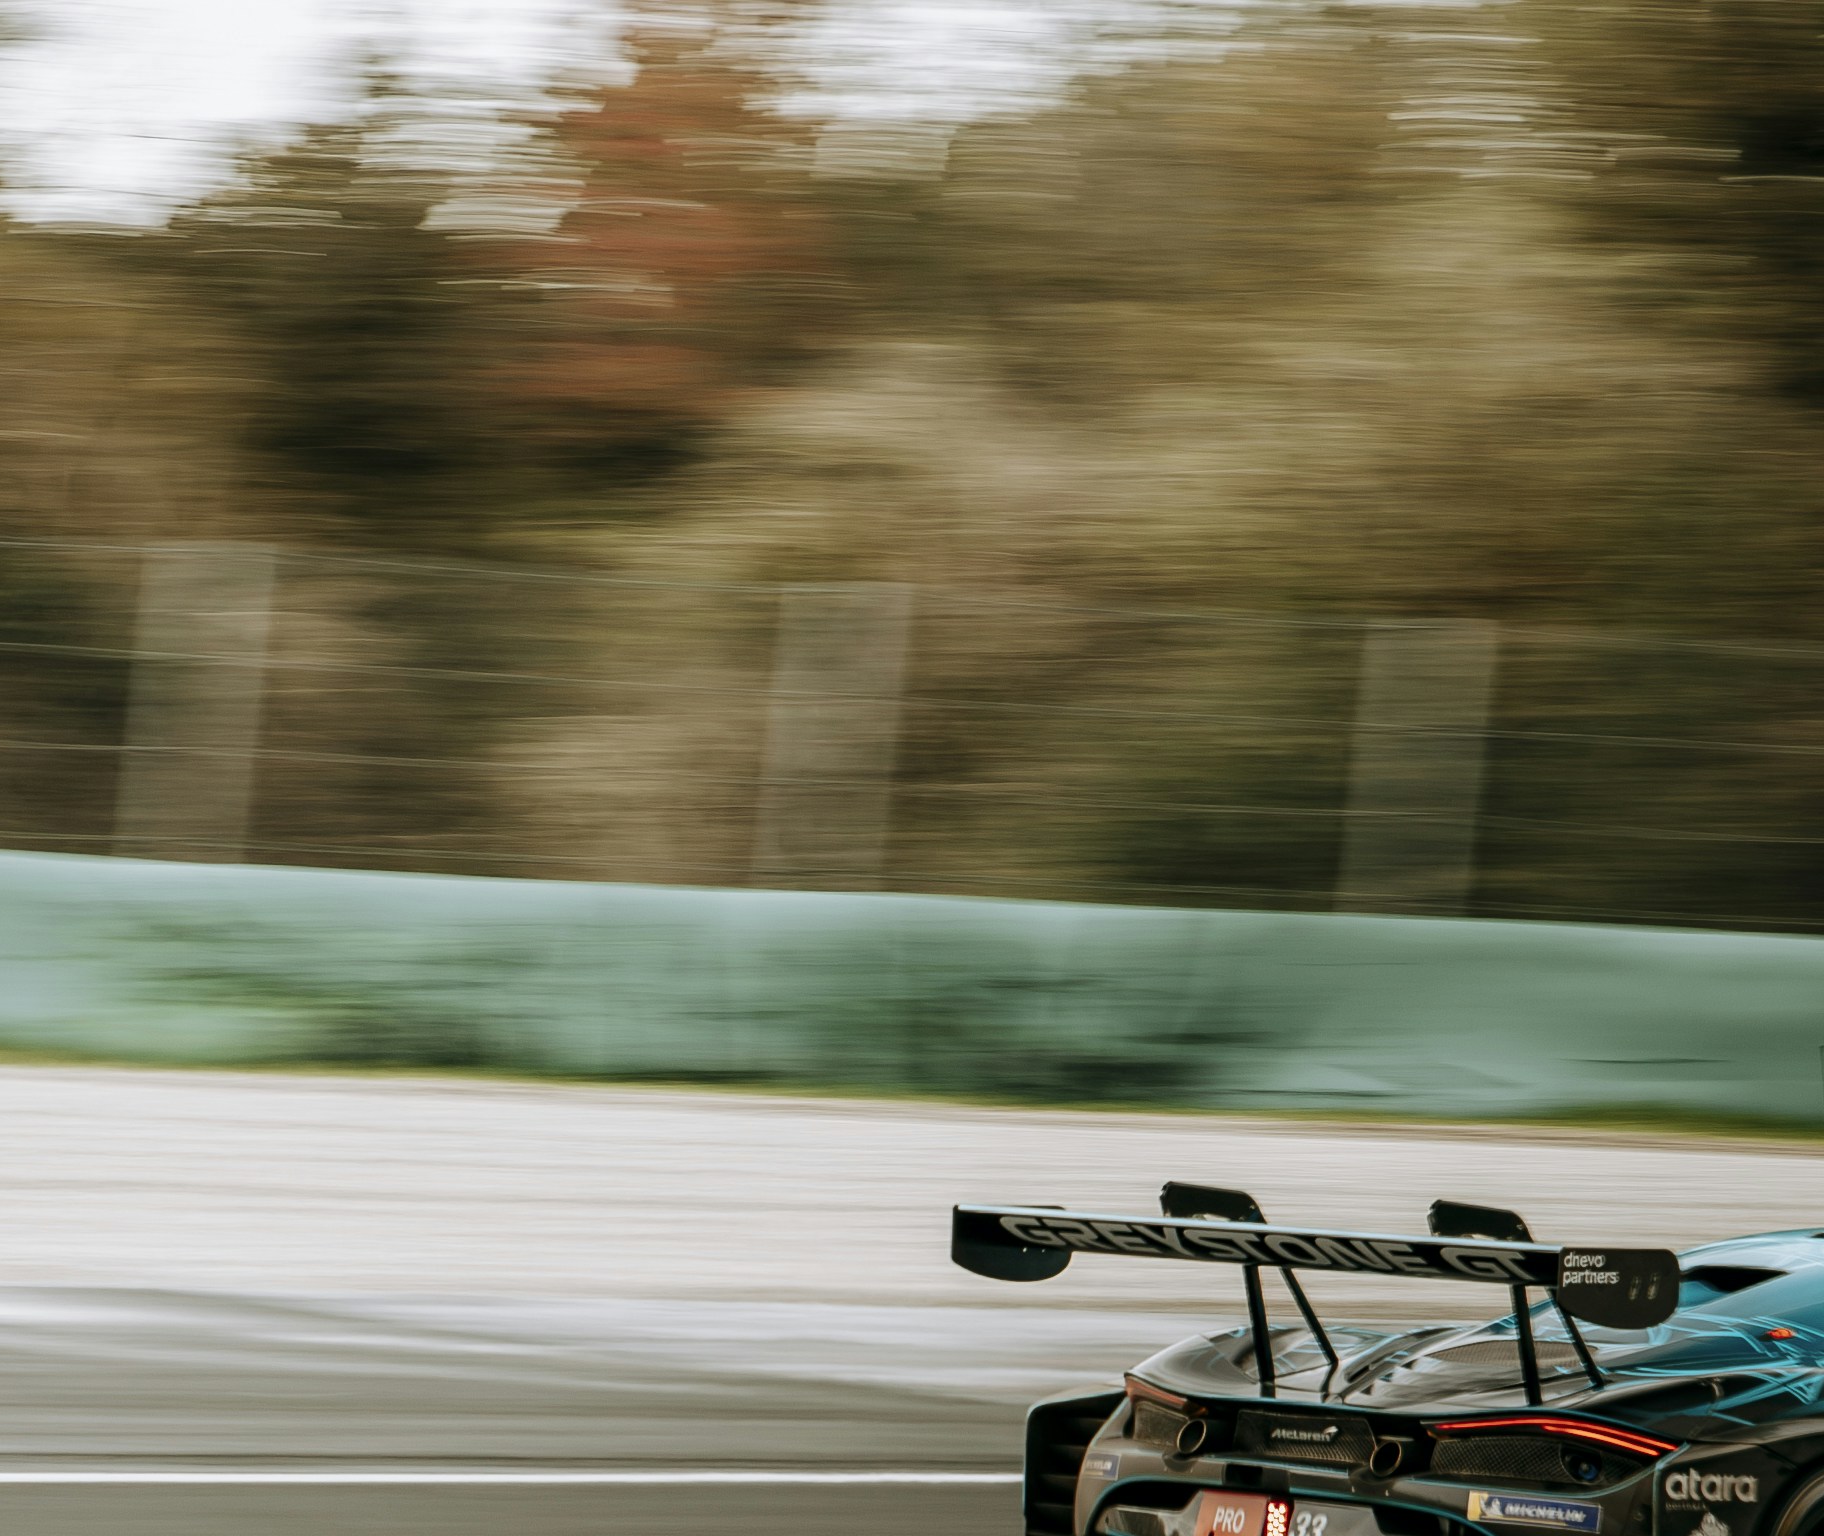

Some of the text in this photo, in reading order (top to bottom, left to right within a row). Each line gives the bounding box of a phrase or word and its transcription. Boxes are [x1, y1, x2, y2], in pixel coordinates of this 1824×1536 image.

[999, 1215, 1538, 1281] GREYSTONE GT
[1562, 1269, 1620, 1288] partners
[1271, 1427, 1332, 1443] McLaren
[1665, 1467, 1759, 1502] atara
[1212, 1505, 1246, 1535] PRO
